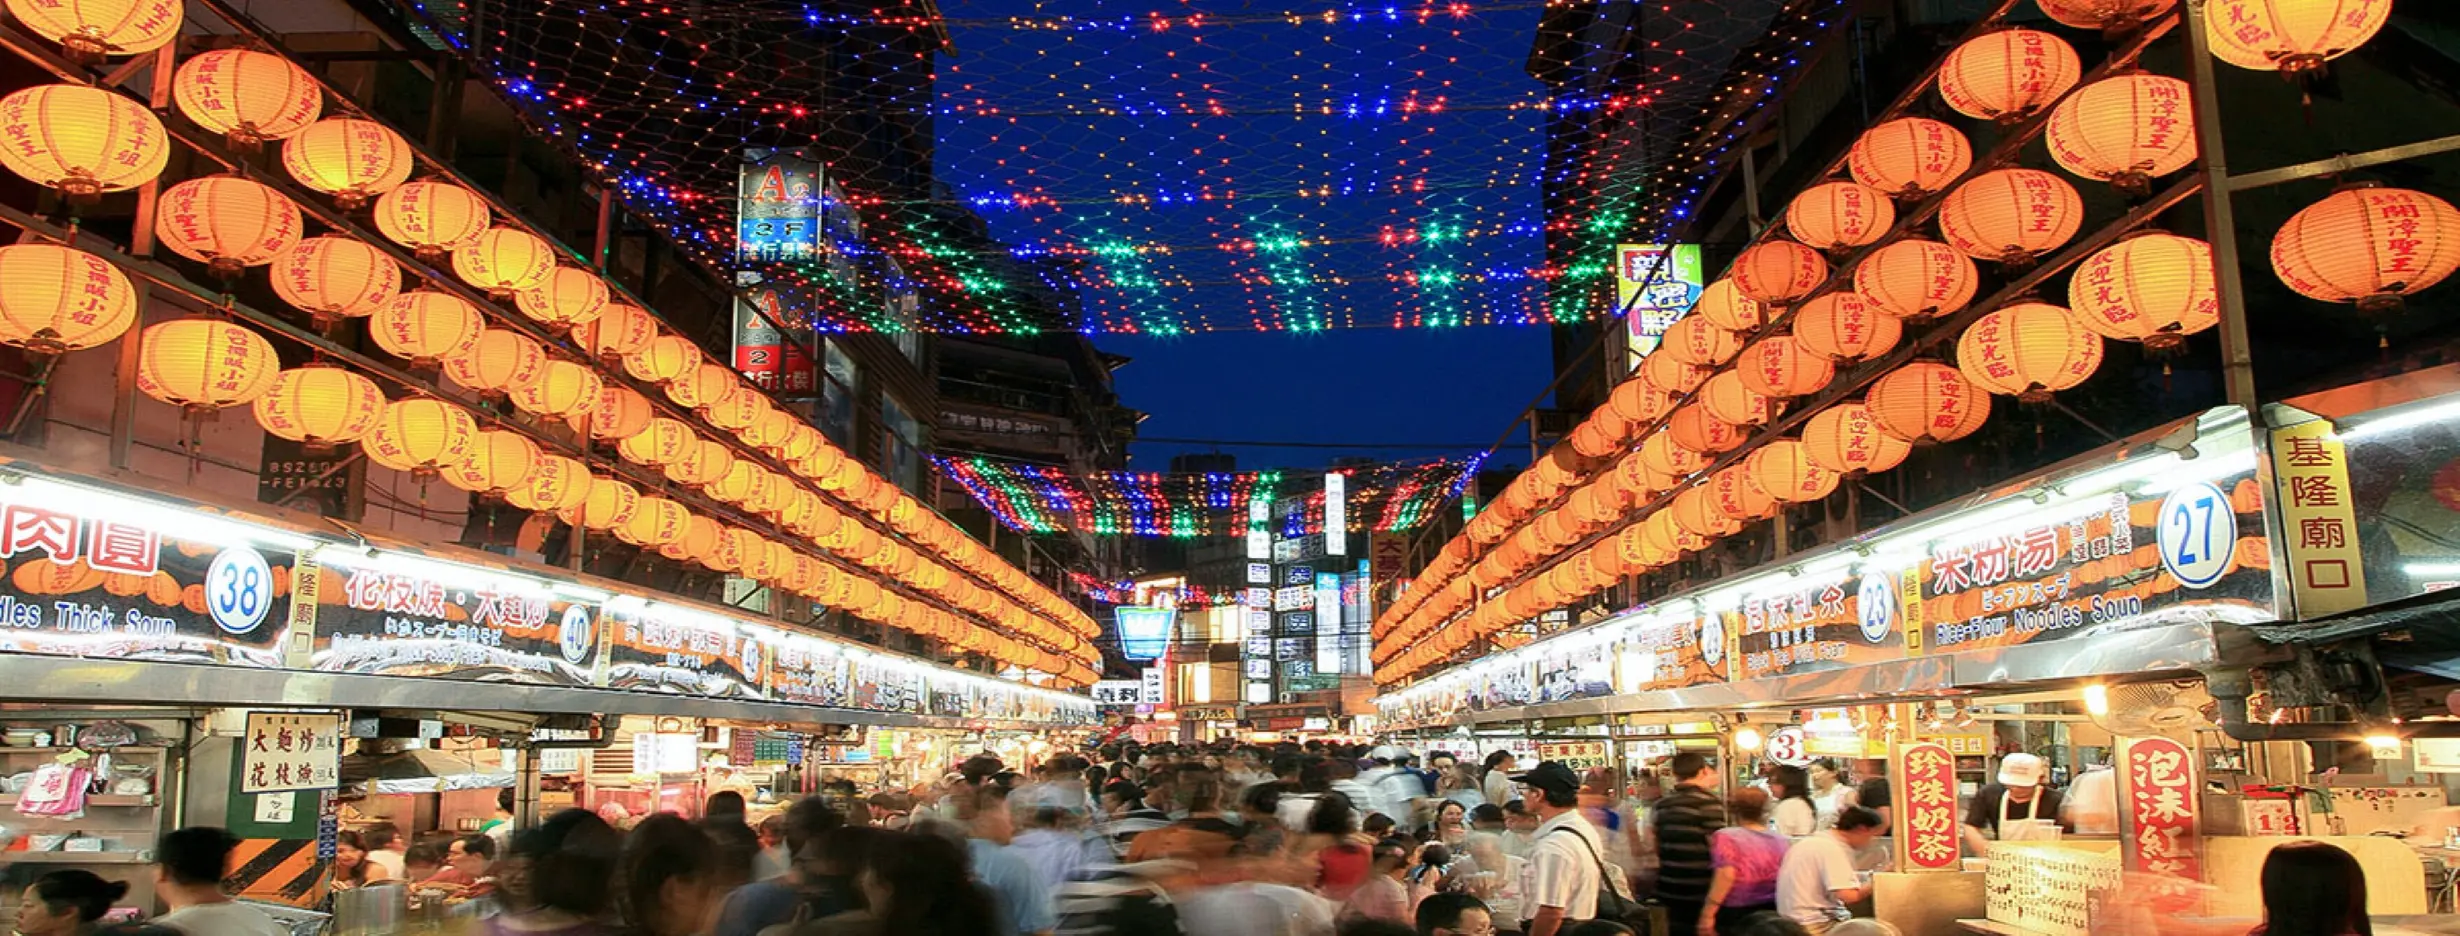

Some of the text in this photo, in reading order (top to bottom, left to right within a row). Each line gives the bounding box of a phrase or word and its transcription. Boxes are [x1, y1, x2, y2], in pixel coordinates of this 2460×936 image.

[2380, 205, 2423, 274] 開漳聖王
[2, 505, 158, 574] 肉圓
[2174, 496, 2214, 566] 27
[2284, 435, 2351, 589] 基隆廟口
[220, 563, 260, 617] 38
[1934, 527, 2057, 593] 米粉湯
[56, 602, 114, 632] Thick
[1866, 583, 1886, 628] 23
[1936, 616, 2006, 645] Rice-Flour
[2014, 603, 2082, 632] Noodles
[1908, 749, 1956, 863] 珍珠奶茶
